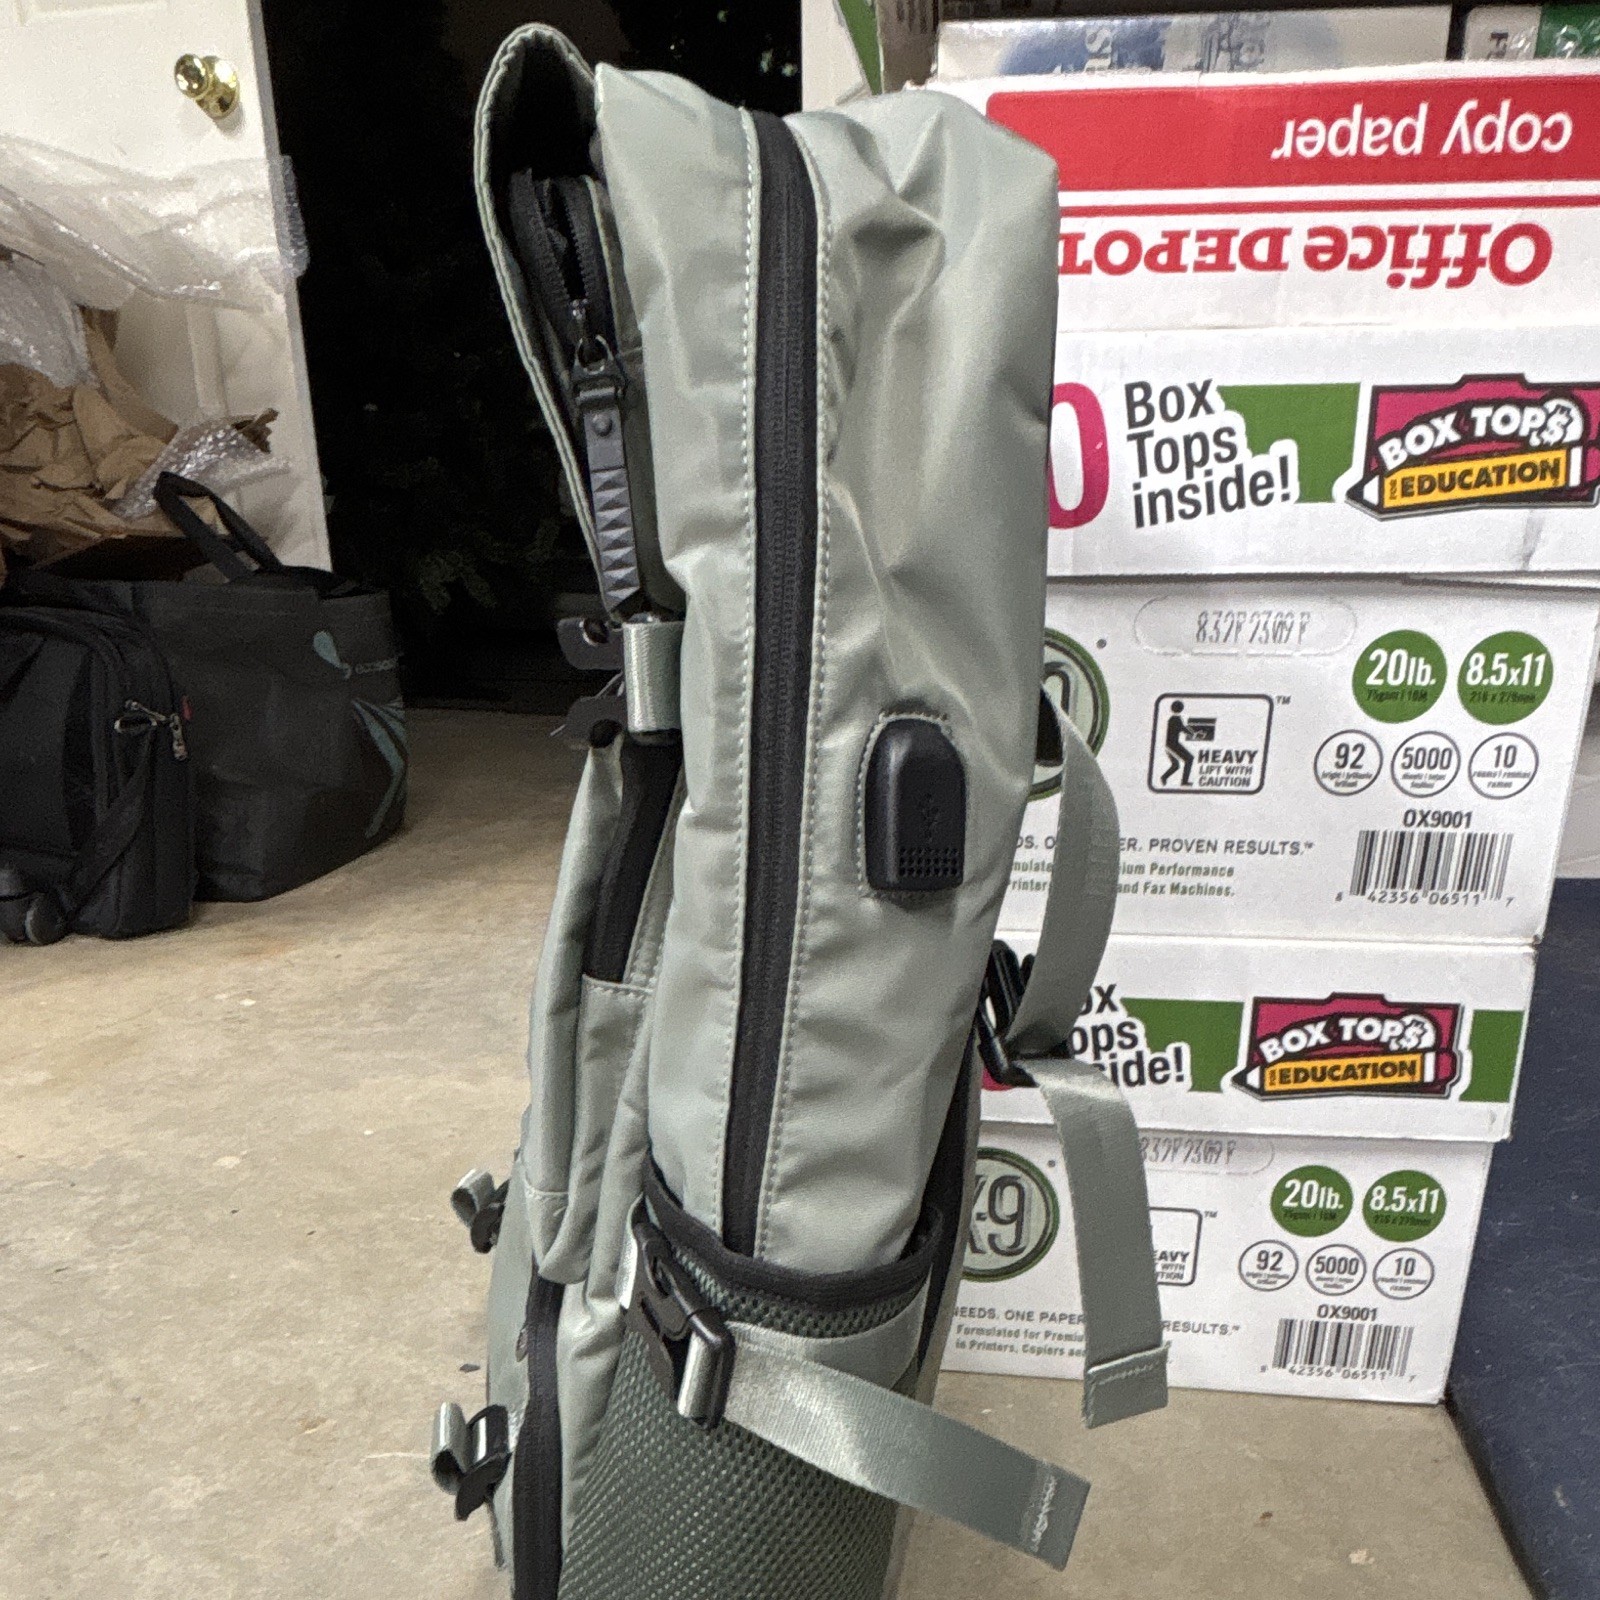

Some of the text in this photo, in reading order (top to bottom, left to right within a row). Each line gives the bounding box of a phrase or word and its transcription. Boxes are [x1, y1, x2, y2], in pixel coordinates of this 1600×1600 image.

[1270, 98, 1573, 160] copy paper
[1058, 222, 1553, 289] Office DEPOT
[1124, 378, 1215, 430] Box
[1126, 426, 1238, 481] Tops
[1378, 412, 1462, 471] BOX
[1400, 456, 1562, 499] EDUCATION
[1132, 454, 1291, 529] inside!
[1365, 648, 1437, 687] 20lb.
[1465, 652, 1547, 688] 8.5x11
[1197, 749, 1259, 764] HEAVY
[1334, 742, 1367, 770] 92
[1400, 746, 1453, 771] 5000
[1493, 744, 1518, 769] 10
[1198, 765, 1254, 776] LIFT WITH
[1198, 776, 1251, 787] CAUTION
[1149, 838, 1217, 853] PROVEN
[1150, 862, 1234, 877] Performance
[1143, 882, 1166, 896] Fax
[1169, 883, 1235, 897] Machines.
[1367, 891, 1419, 904] 42356
[1069, 1021, 1139, 1061] ops
[1259, 1020, 1331, 1063] BOX
[1278, 1060, 1418, 1085] EDUCATION
[1282, 1179, 1344, 1210] 20lb.
[1369, 1185, 1440, 1214] 8.5x11
[1256, 1250, 1284, 1272] 92
[1314, 1256, 1359, 1276] 5000
[1394, 1257, 1416, 1276] 10
[1004, 1309, 1035, 1322] ONE
[956, 1324, 1020, 1339] Formulated
[1024, 1329, 1041, 1341] for
[1021, 1344, 1064, 1357] Copiers
[1288, 1364, 1333, 1378] 42356
